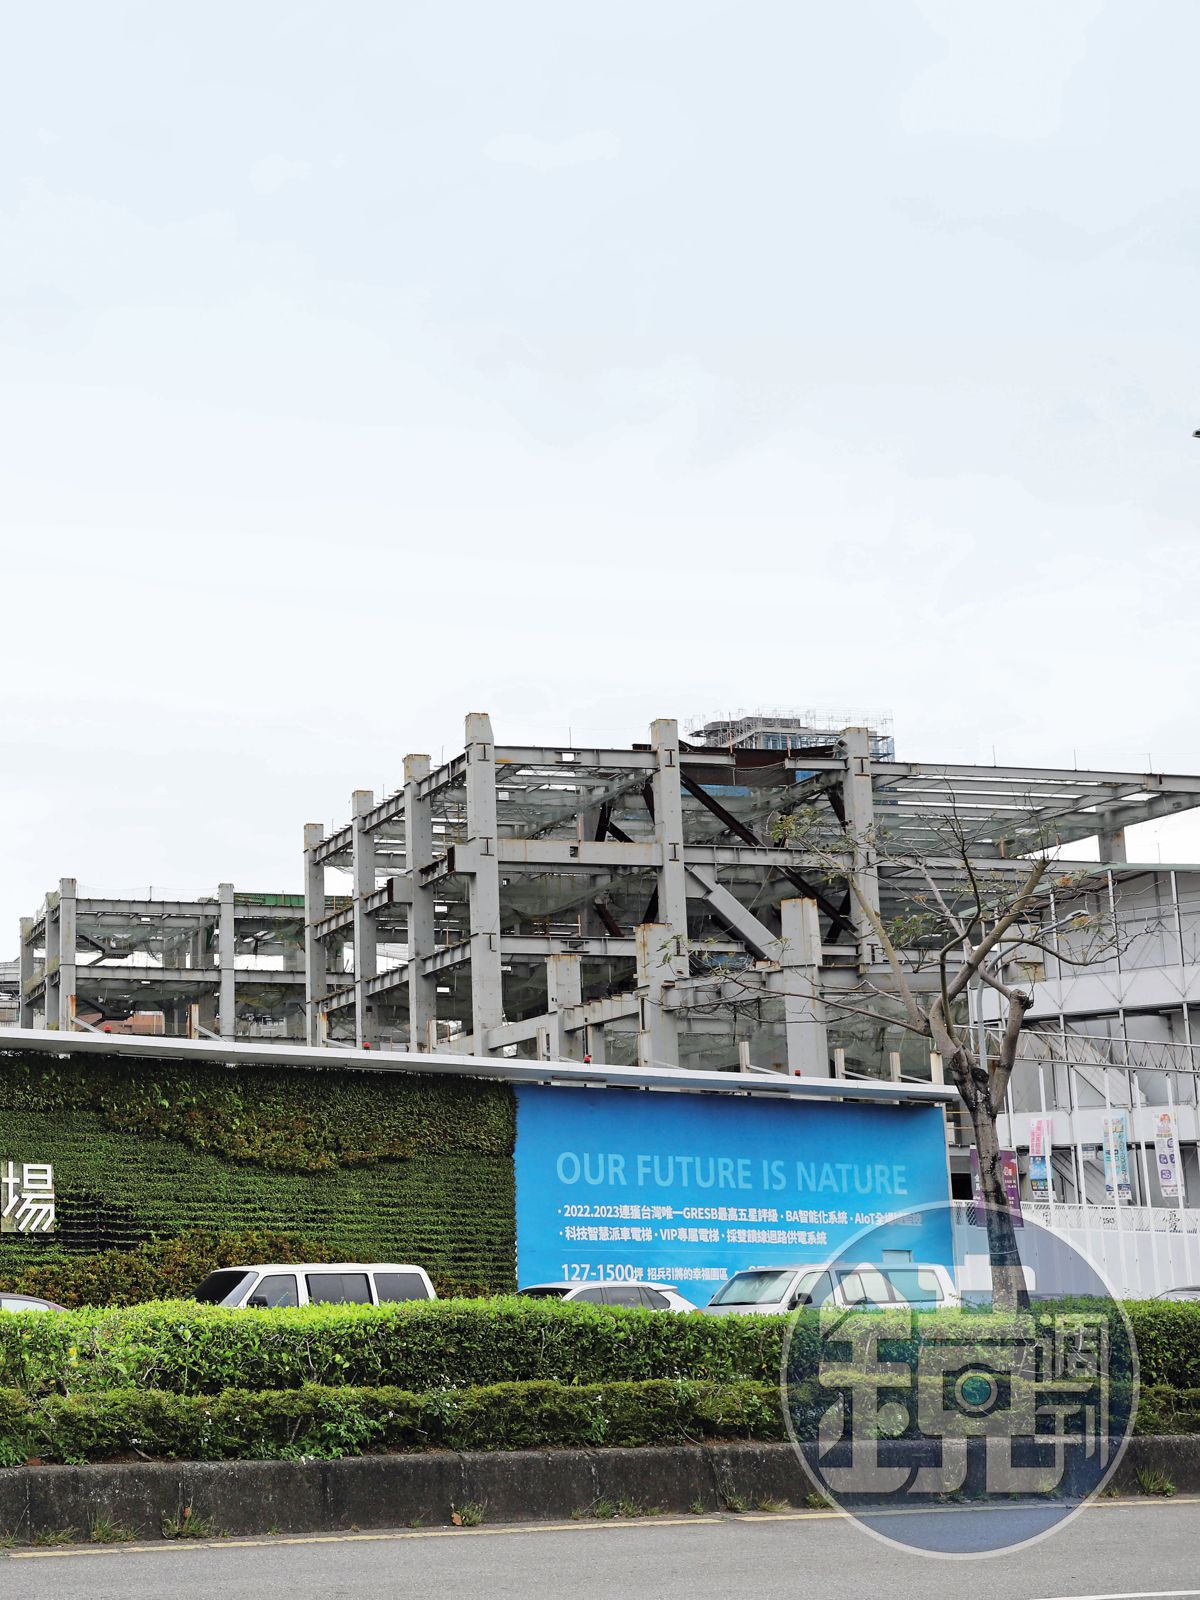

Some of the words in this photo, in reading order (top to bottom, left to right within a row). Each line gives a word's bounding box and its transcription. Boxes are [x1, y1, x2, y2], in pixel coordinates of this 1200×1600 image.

[556, 1151, 626, 1186] OUR
[637, 1155, 752, 1190] FUTURE
[762, 1159, 787, 1191] IS
[797, 1161, 908, 1196] NATURE
